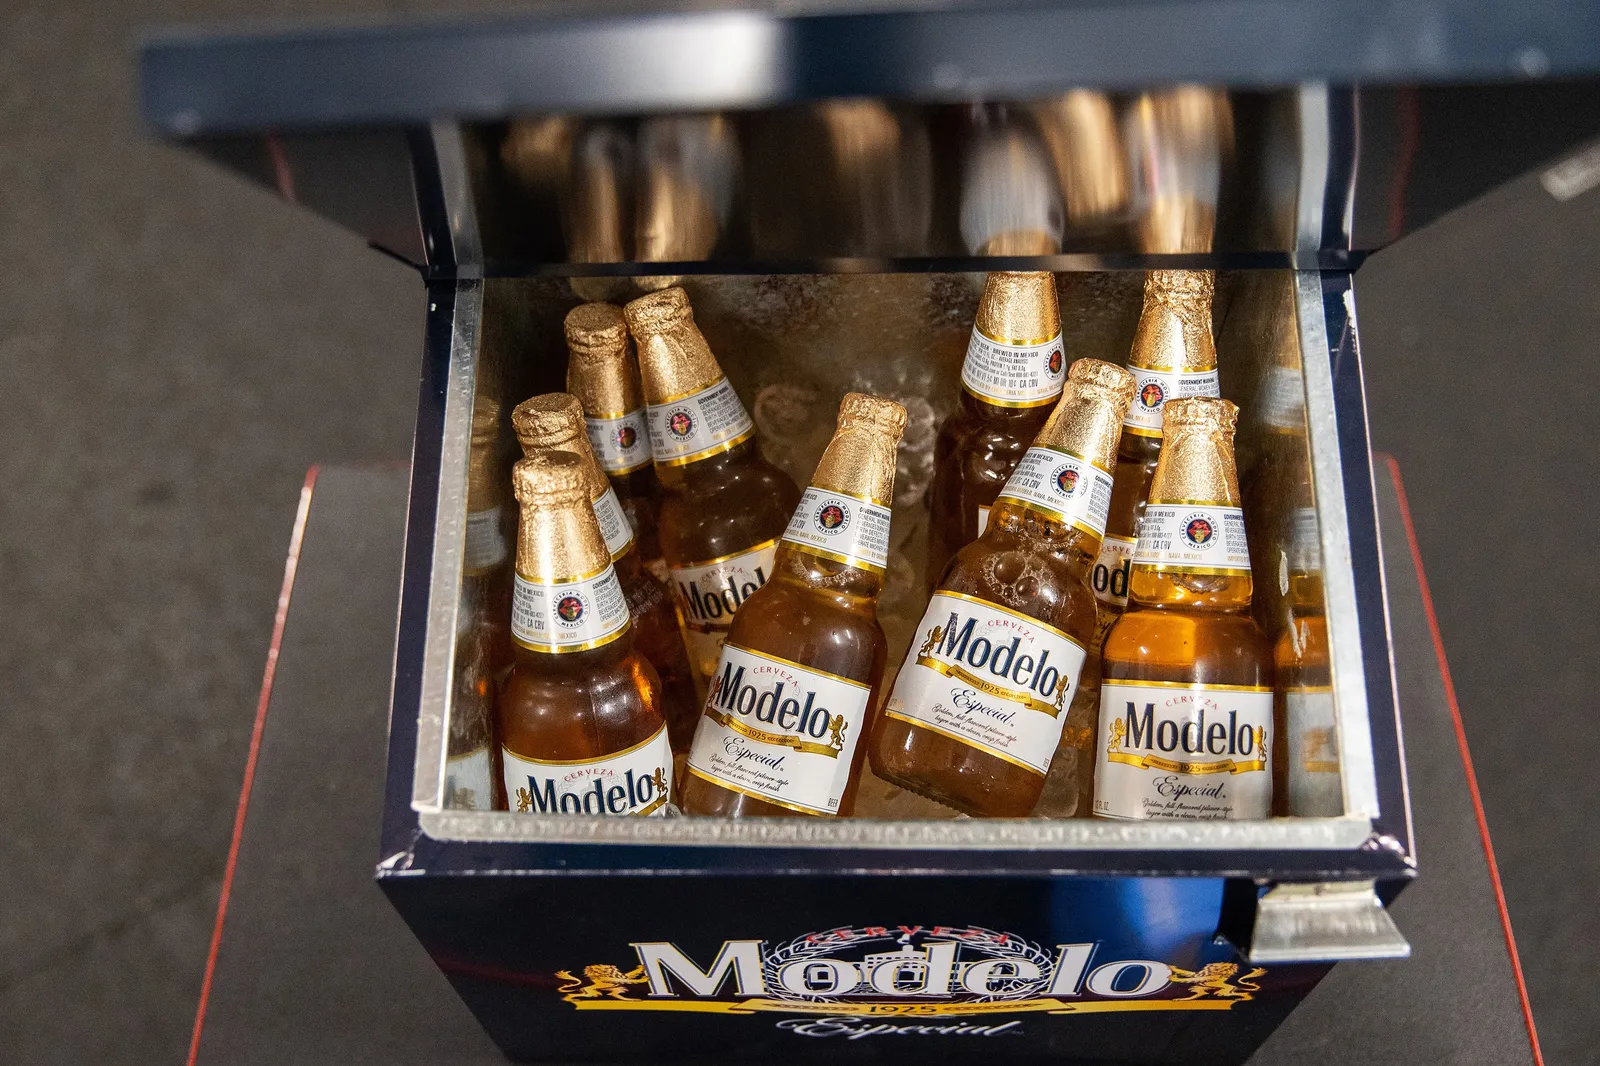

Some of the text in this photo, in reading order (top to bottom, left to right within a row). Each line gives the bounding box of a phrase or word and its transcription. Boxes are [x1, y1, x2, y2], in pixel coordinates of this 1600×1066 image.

[993, 347, 1013, 358] BREWED
[1019, 379, 1027, 389] CA
[1028, 379, 1039, 388] CRV
[1140, 405, 1161, 413] MEXICO
[815, 500, 841, 522] CERVECERIA
[817, 525, 839, 535] MEXICO
[1180, 513, 1205, 540] CERVECERIA
[1187, 541, 1212, 550] MEXICO
[526, 588, 545, 598] MEXICO
[527, 617, 534, 629] CA
[534, 619, 545, 630] CRV
[561, 619, 584, 628] MEXICO
[986, 618, 1037, 645] CERVEZA
[935, 611, 1061, 698] Modelo
[752, 665, 799, 688] CERVEZA
[980, 681, 1001, 695] 1925
[715, 661, 833, 740] Modelo
[950, 687, 1017, 726] Especial
[748, 729, 767, 741] 1925
[1124, 700, 1254, 757] Modelo
[723, 735, 786, 771] Especial
[563, 767, 614, 782] CERVEZA
[1180, 763, 1202, 773] 1925
[526, 767, 654, 815] Modelo
[1152, 775, 1225, 801] Especial
[805, 925, 1009, 945] CERVEZA
[628, 939, 1174, 1000] Modelo
[869, 1005, 937, 1014] 1925
[775, 1016, 1022, 1041] Especial
